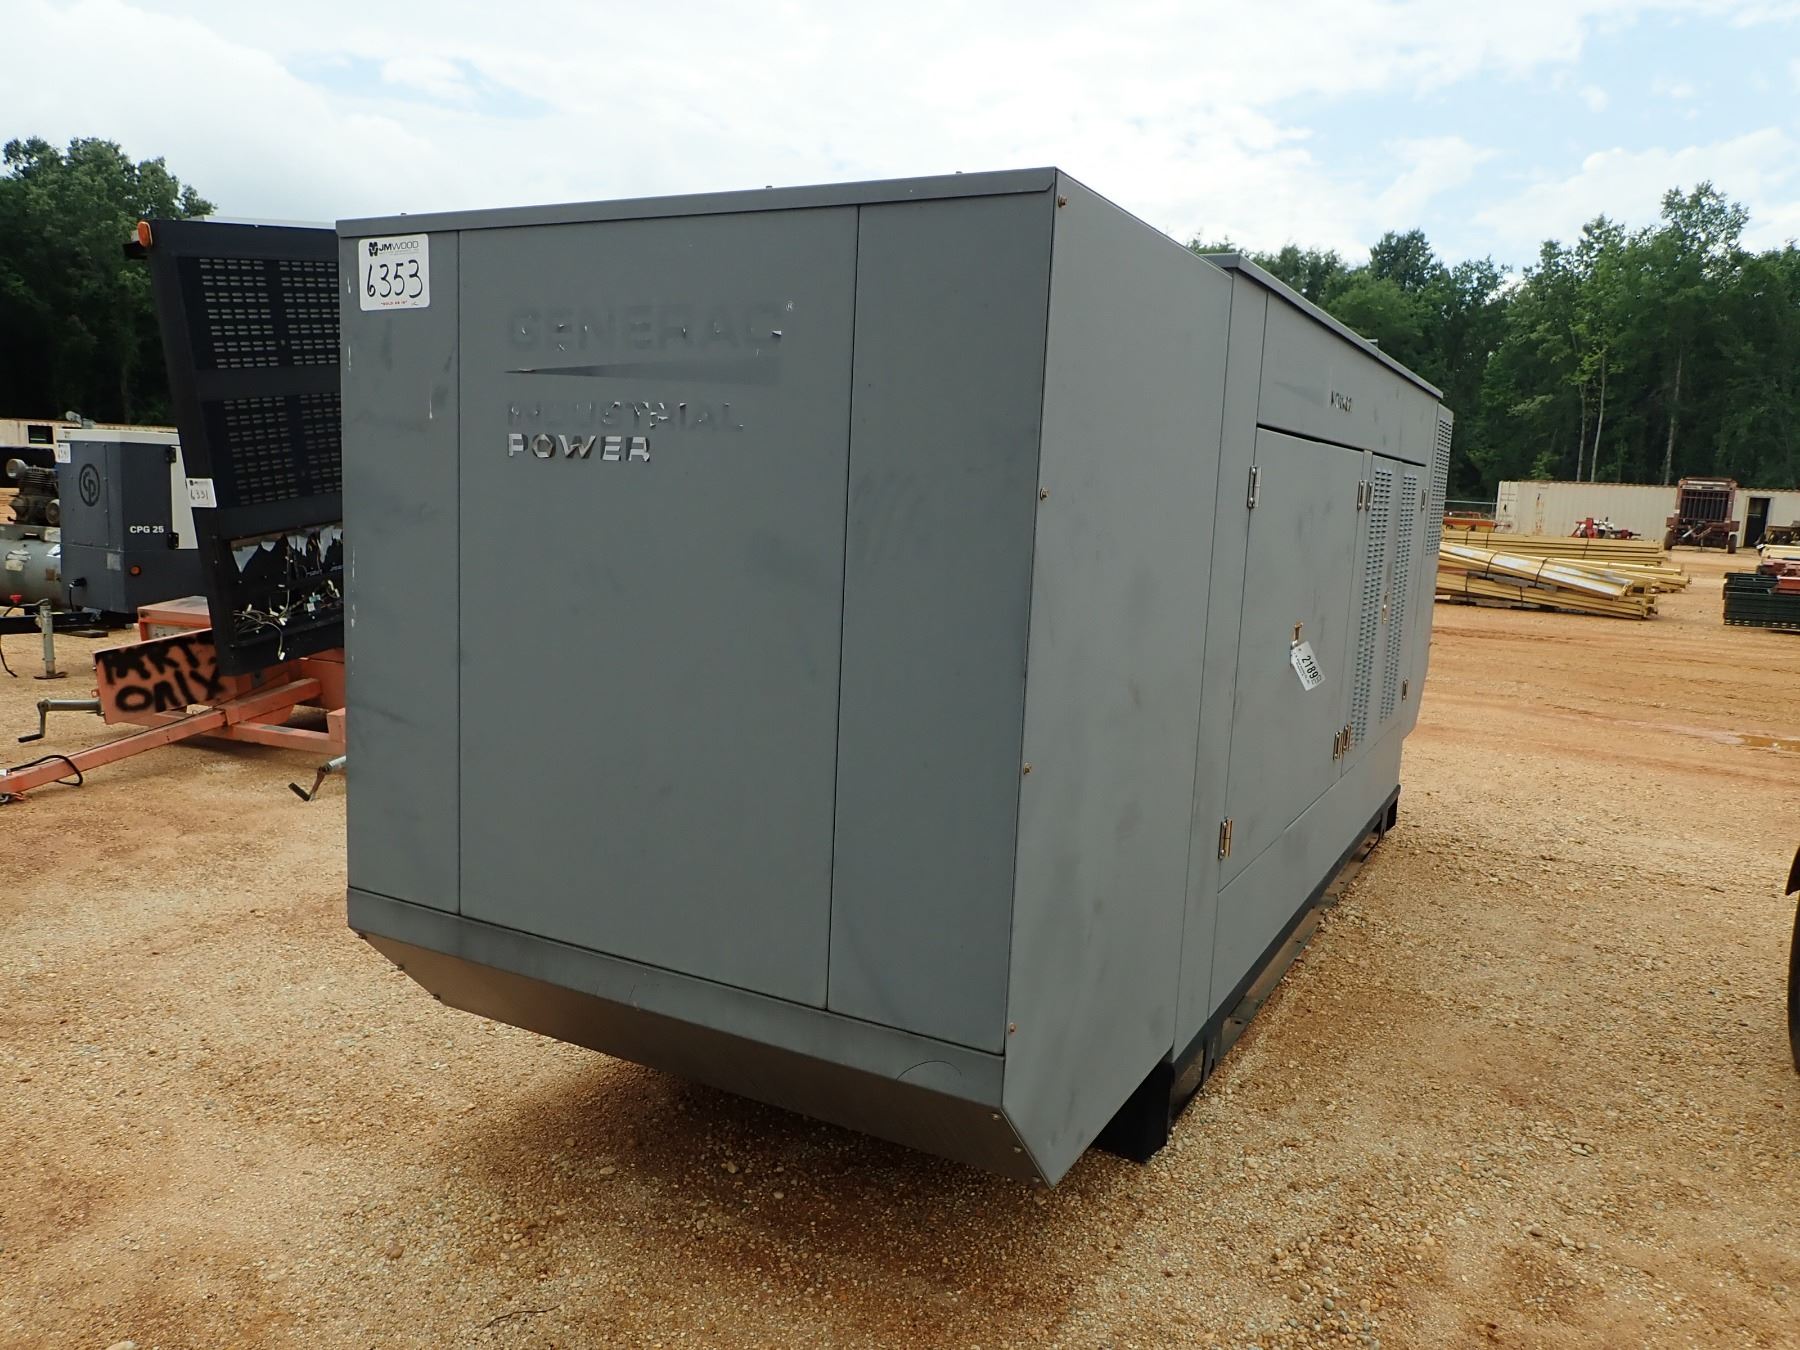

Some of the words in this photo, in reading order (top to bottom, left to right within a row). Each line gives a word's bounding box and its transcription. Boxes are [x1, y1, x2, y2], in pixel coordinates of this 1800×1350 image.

[366, 259, 424, 299] 6353
[507, 432, 652, 463] POWER
[129, 525, 151, 534] CPG
[152, 525, 165, 533] 25
[1301, 655, 1319, 680] 2189
[115, 668, 224, 713] ONLY
